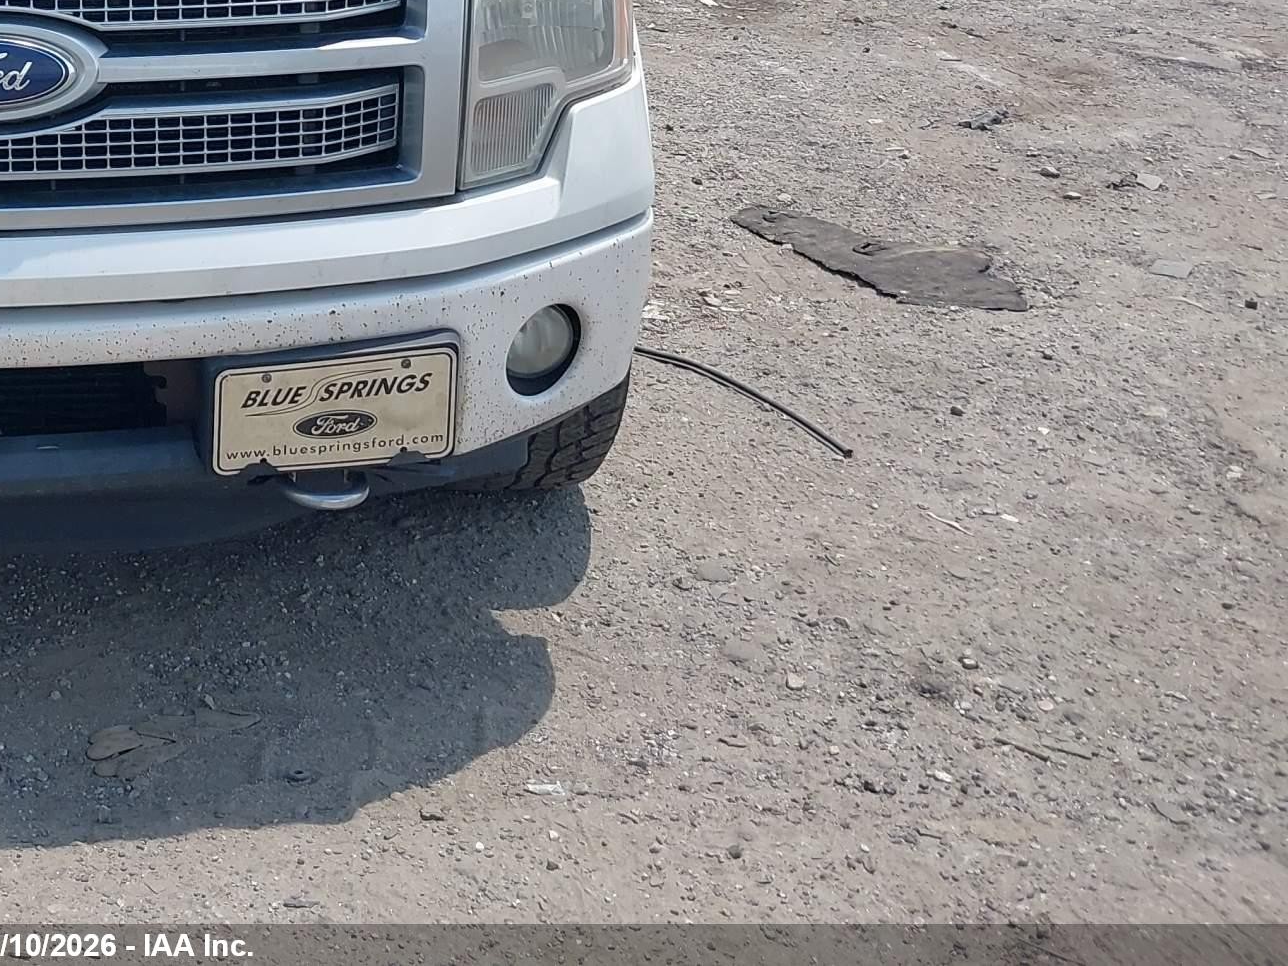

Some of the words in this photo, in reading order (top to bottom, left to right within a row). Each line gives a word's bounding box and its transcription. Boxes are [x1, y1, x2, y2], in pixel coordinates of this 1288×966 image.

[241, 385, 308, 409] BLUE
[318, 372, 433, 402] SPRINGS
[310, 414, 363, 435] Ford
[226, 434, 444, 461] www.bluespringsford.com
